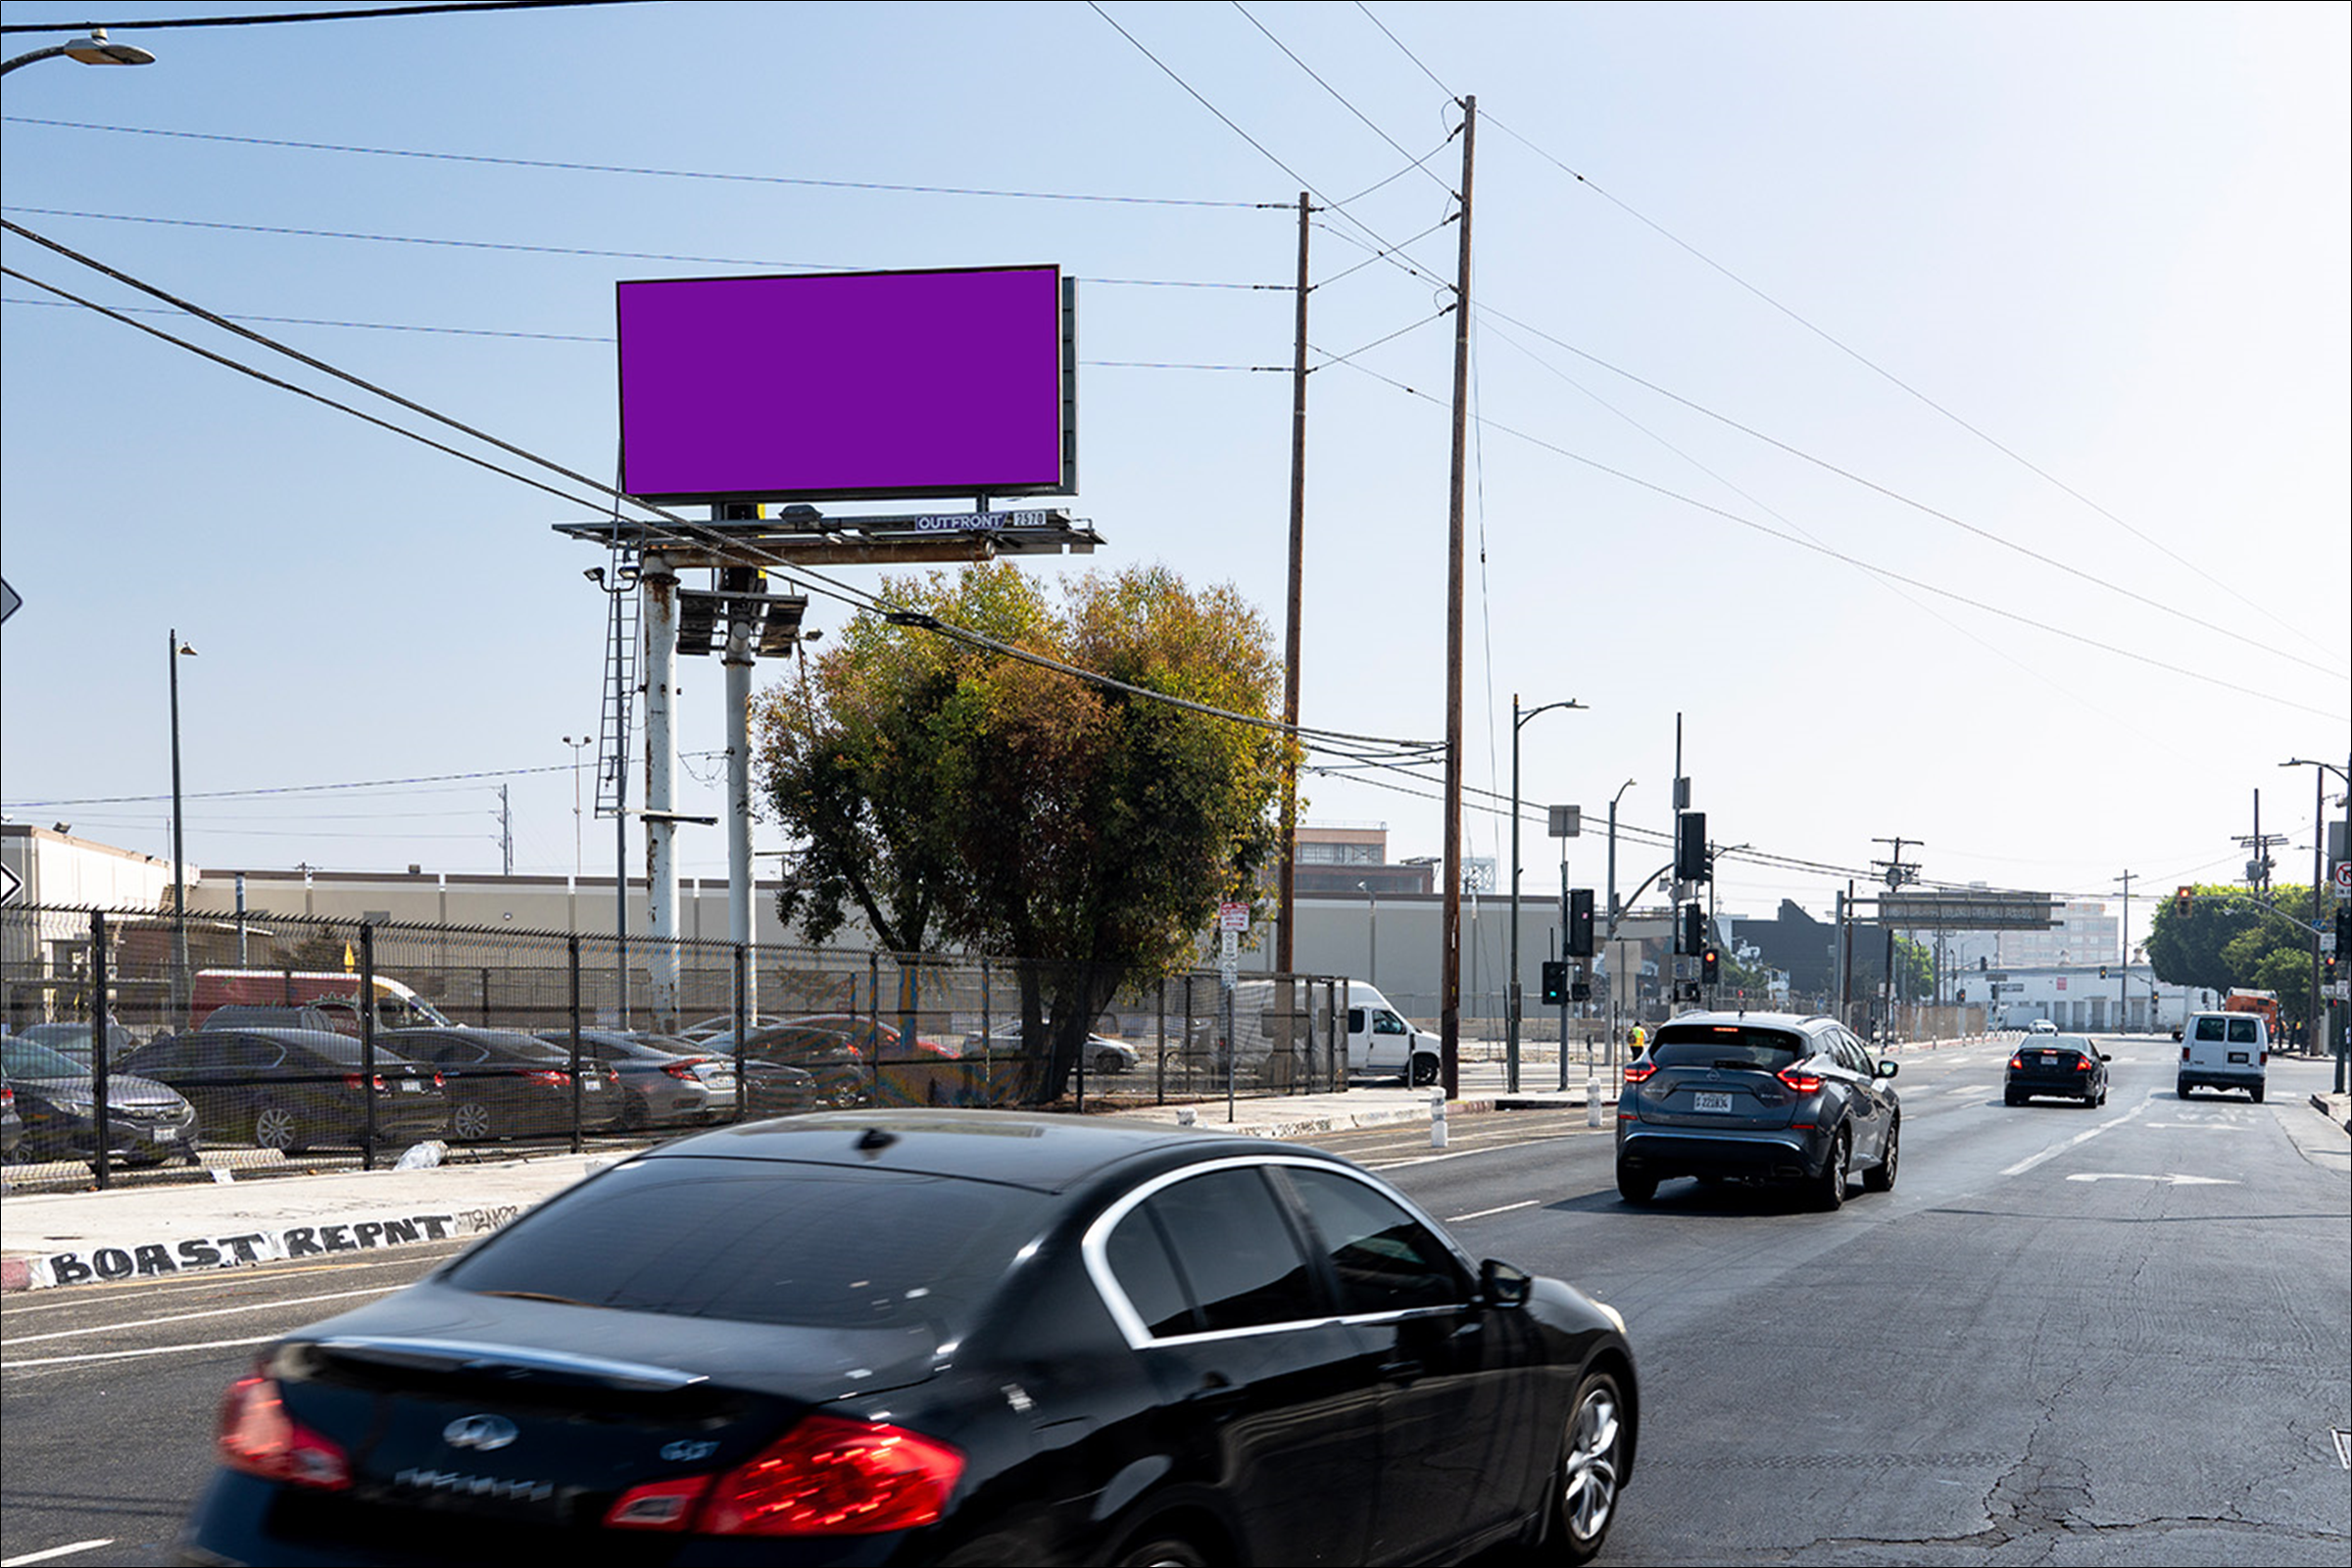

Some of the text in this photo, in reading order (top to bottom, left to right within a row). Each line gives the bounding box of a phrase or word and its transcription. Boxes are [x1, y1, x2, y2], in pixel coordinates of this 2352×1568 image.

[918, 514, 1003, 529] OUTFRONT
[50, 1214, 453, 1285] BOAST REPNT
